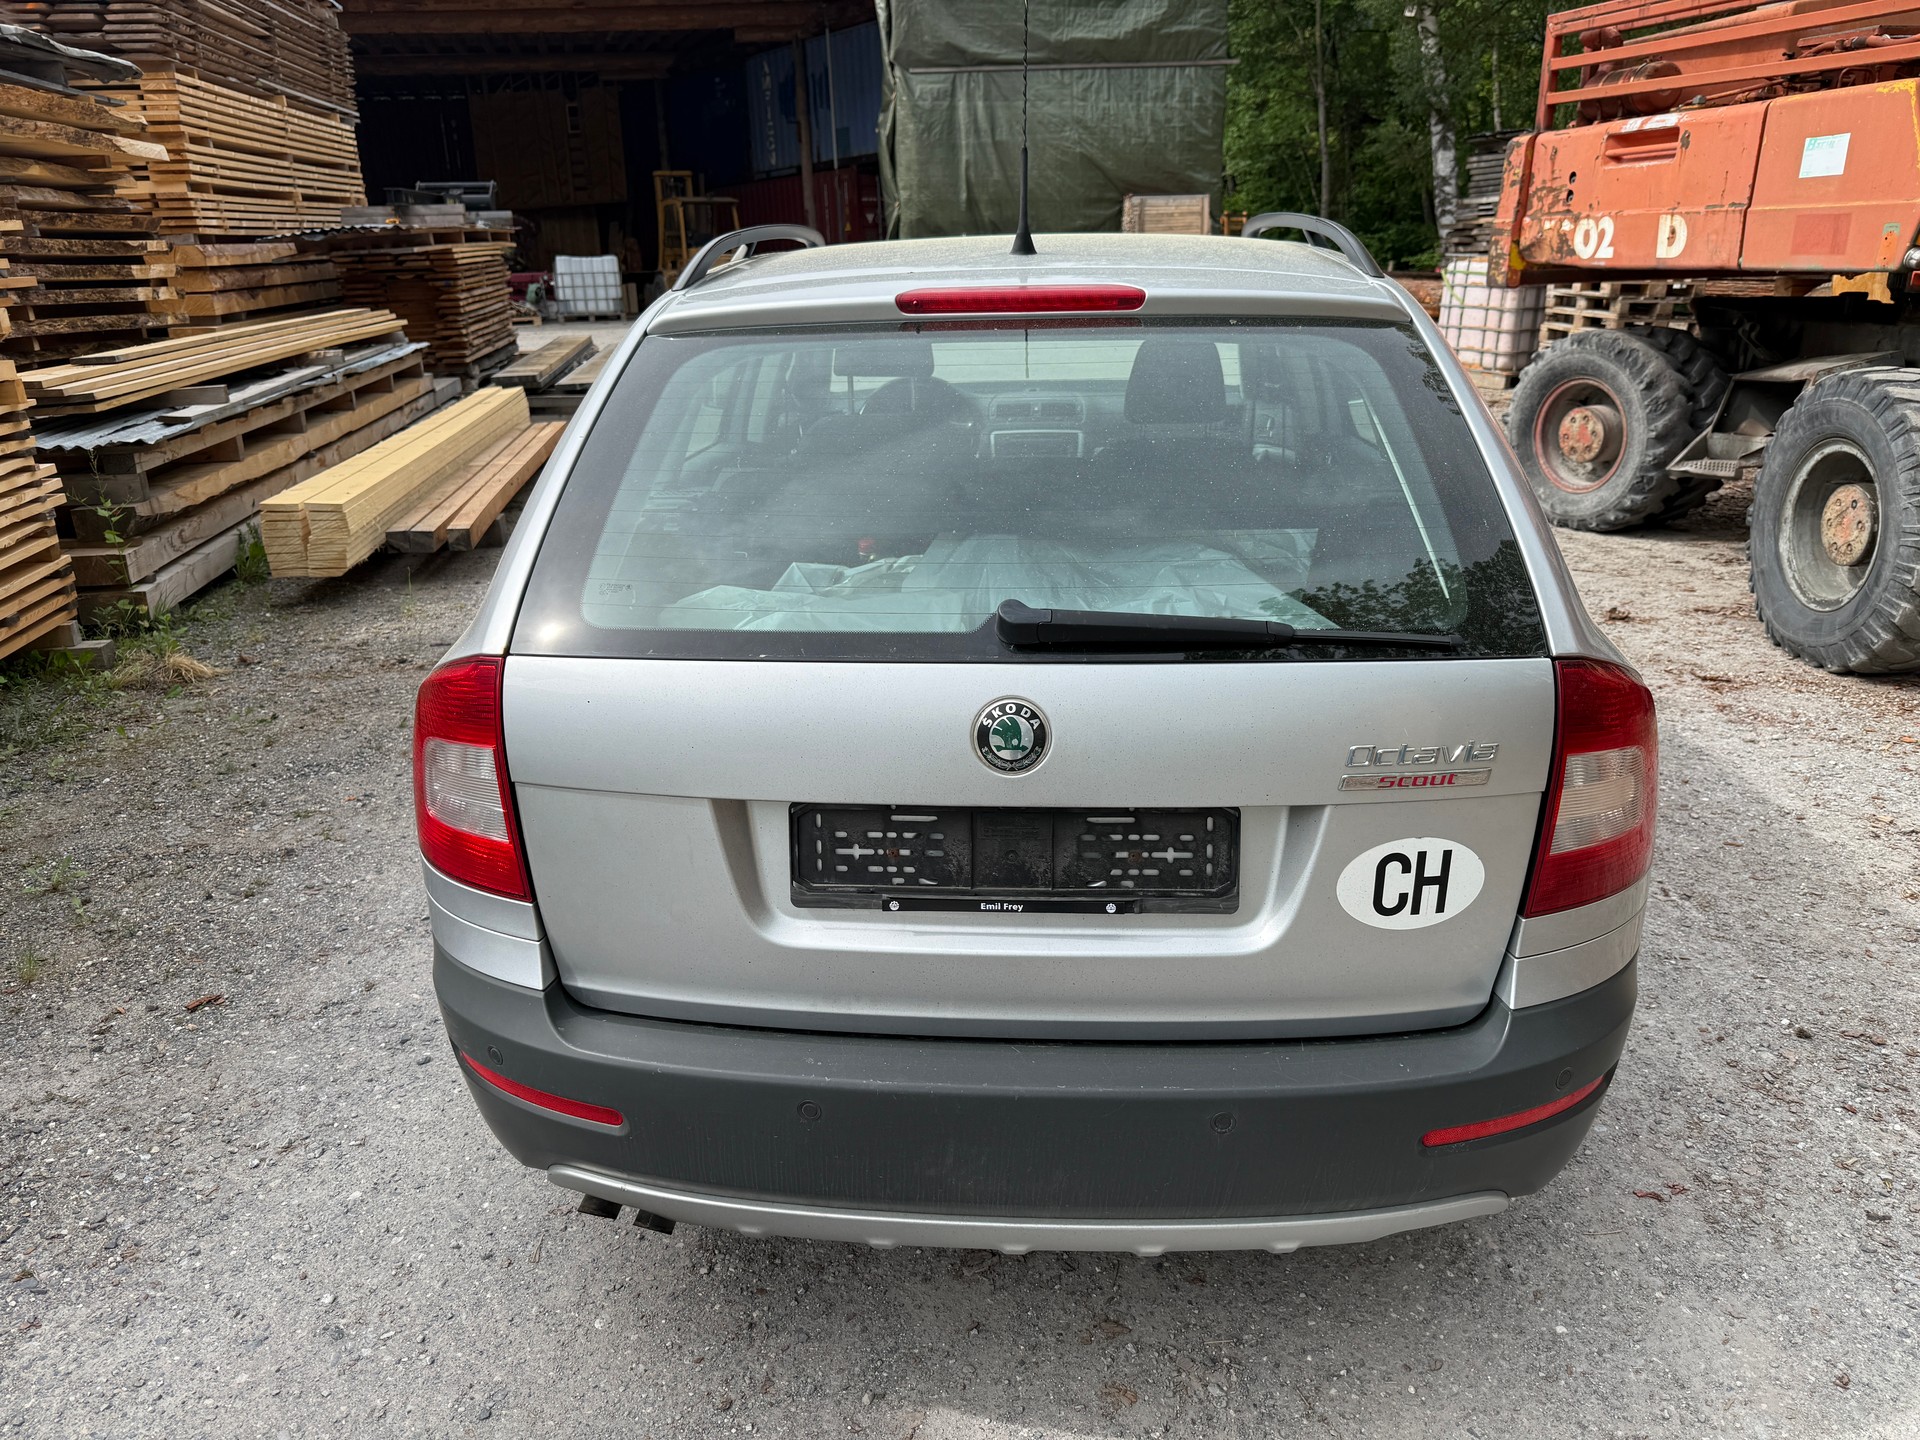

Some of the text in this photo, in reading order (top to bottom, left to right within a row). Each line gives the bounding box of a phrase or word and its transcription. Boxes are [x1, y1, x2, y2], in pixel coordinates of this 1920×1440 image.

[1656, 214, 1687, 258] D
[1345, 740, 1500, 767] Octavia
[1373, 849, 1453, 916] CH
[980, 902, 1024, 912] Emil Frey
